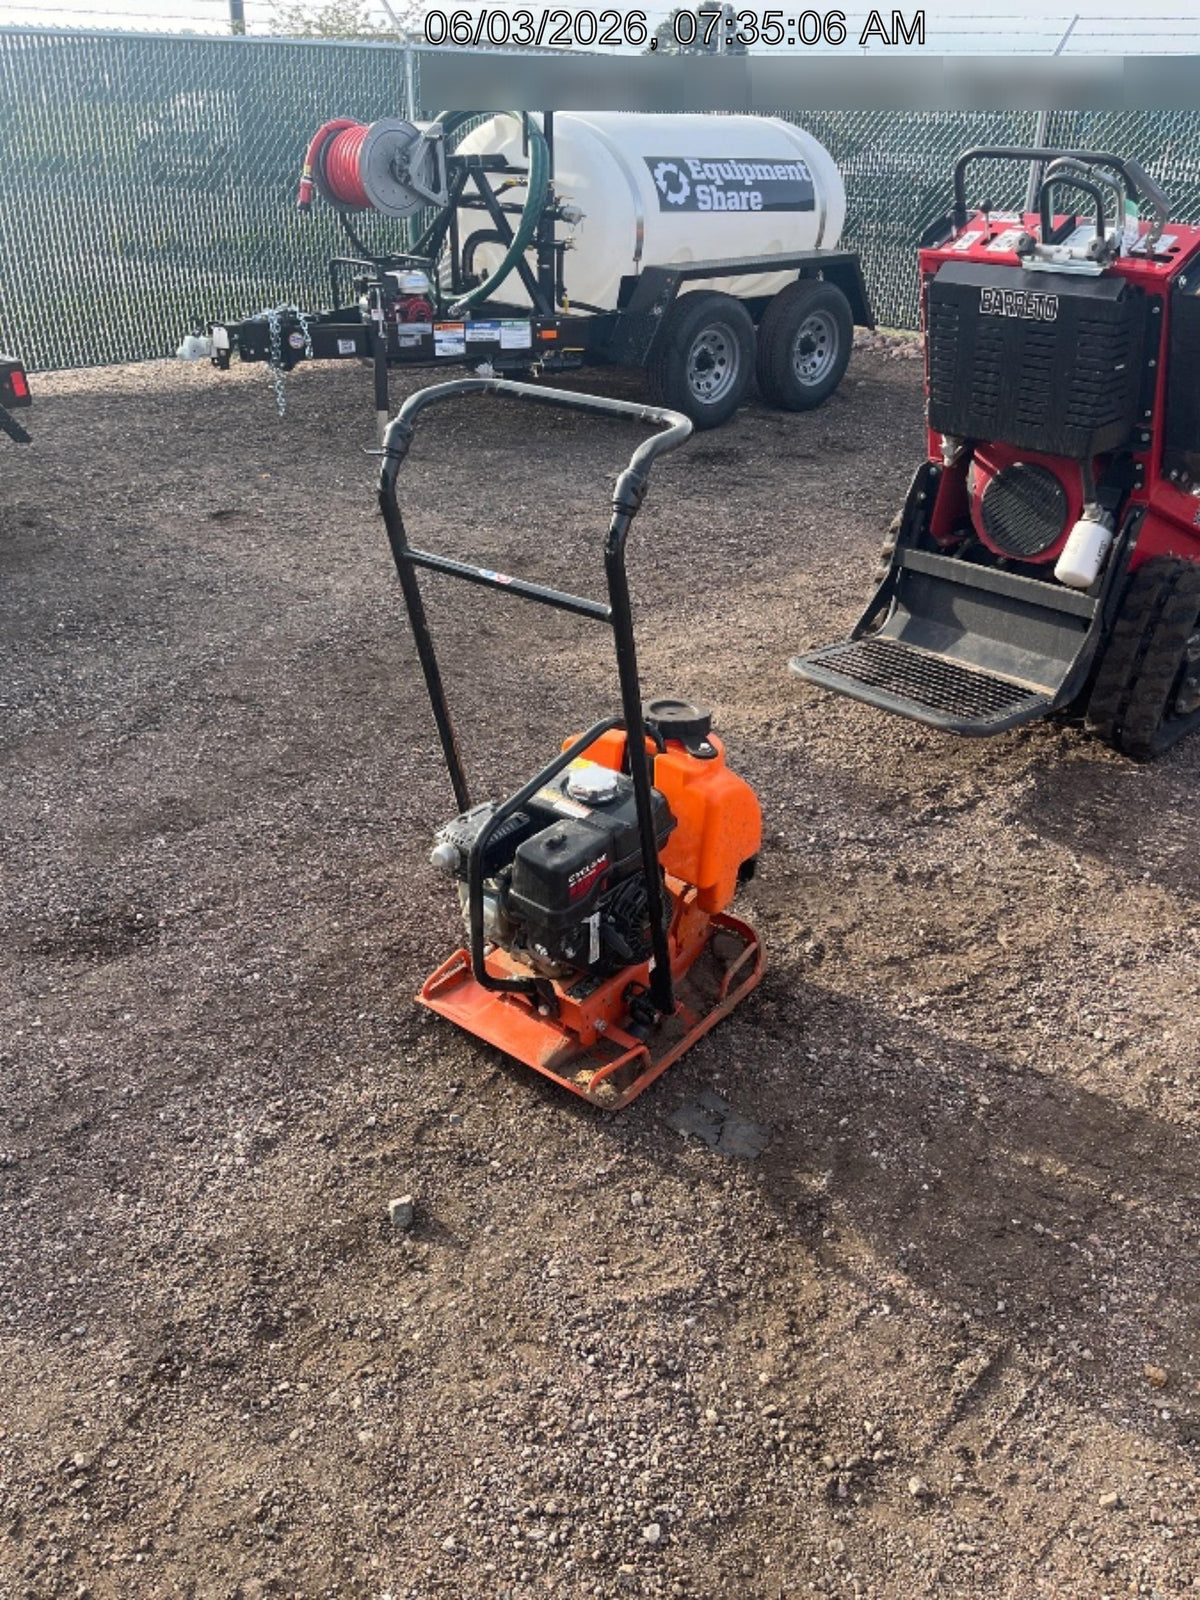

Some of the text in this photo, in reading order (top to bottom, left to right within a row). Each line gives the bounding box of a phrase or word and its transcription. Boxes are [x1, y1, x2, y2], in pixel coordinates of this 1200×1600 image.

[684, 159, 813, 185] Equipment
[695, 184, 763, 211] Share
[980, 287, 1059, 321] BARRETO
